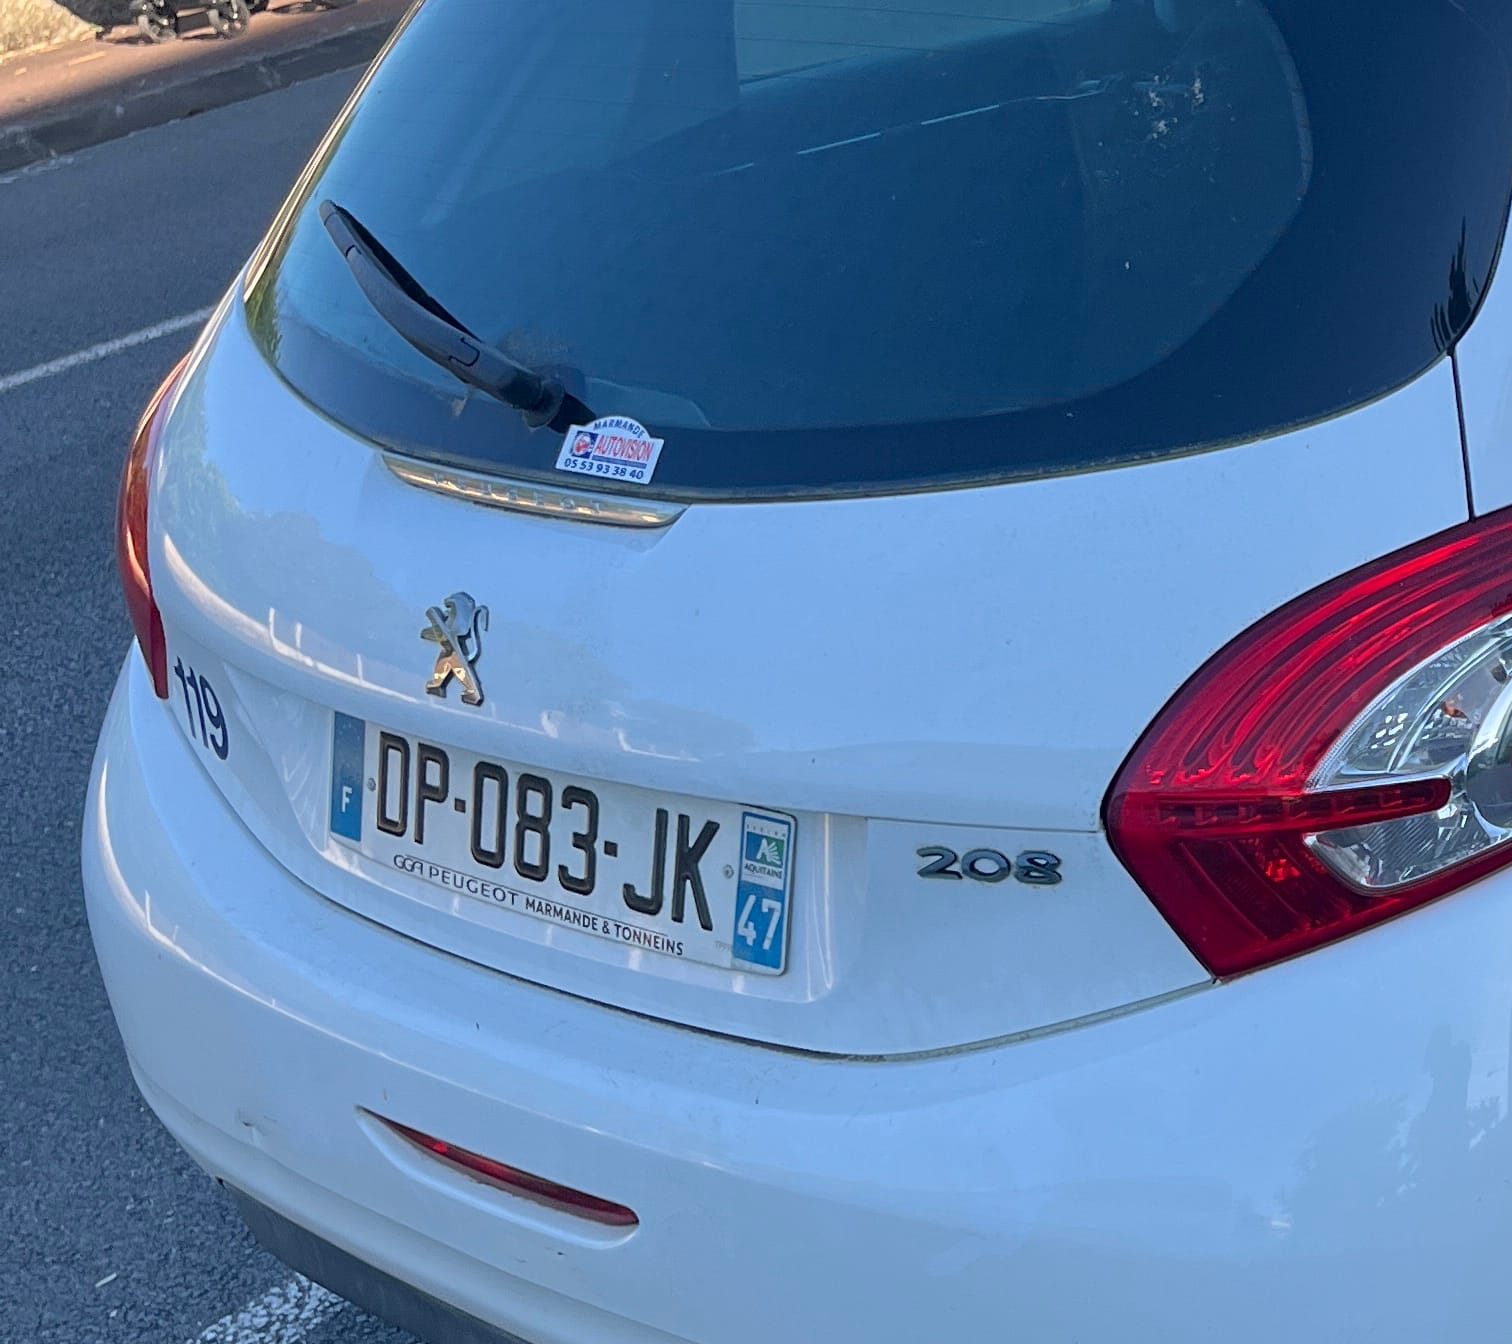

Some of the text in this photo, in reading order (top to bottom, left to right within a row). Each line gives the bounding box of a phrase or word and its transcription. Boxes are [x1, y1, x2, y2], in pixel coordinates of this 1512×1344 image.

[593, 418, 646, 439] MARMANDE
[594, 434, 655, 462] AUTOVISION
[563, 457, 645, 481] 05 53 93 38 40
[173, 655, 229, 761] 119
[341, 786, 353, 813] F
[376, 730, 721, 932] DP-083-JK
[743, 862, 783, 880] AQUITAINE
[916, 845, 1063, 886] 208
[429, 865, 519, 906] PEUGEOT
[525, 896, 599, 933] MARMANDE
[601, 919, 611, 935] &
[614, 922, 684, 957] TONNEINS
[737, 893, 782, 951] 47
